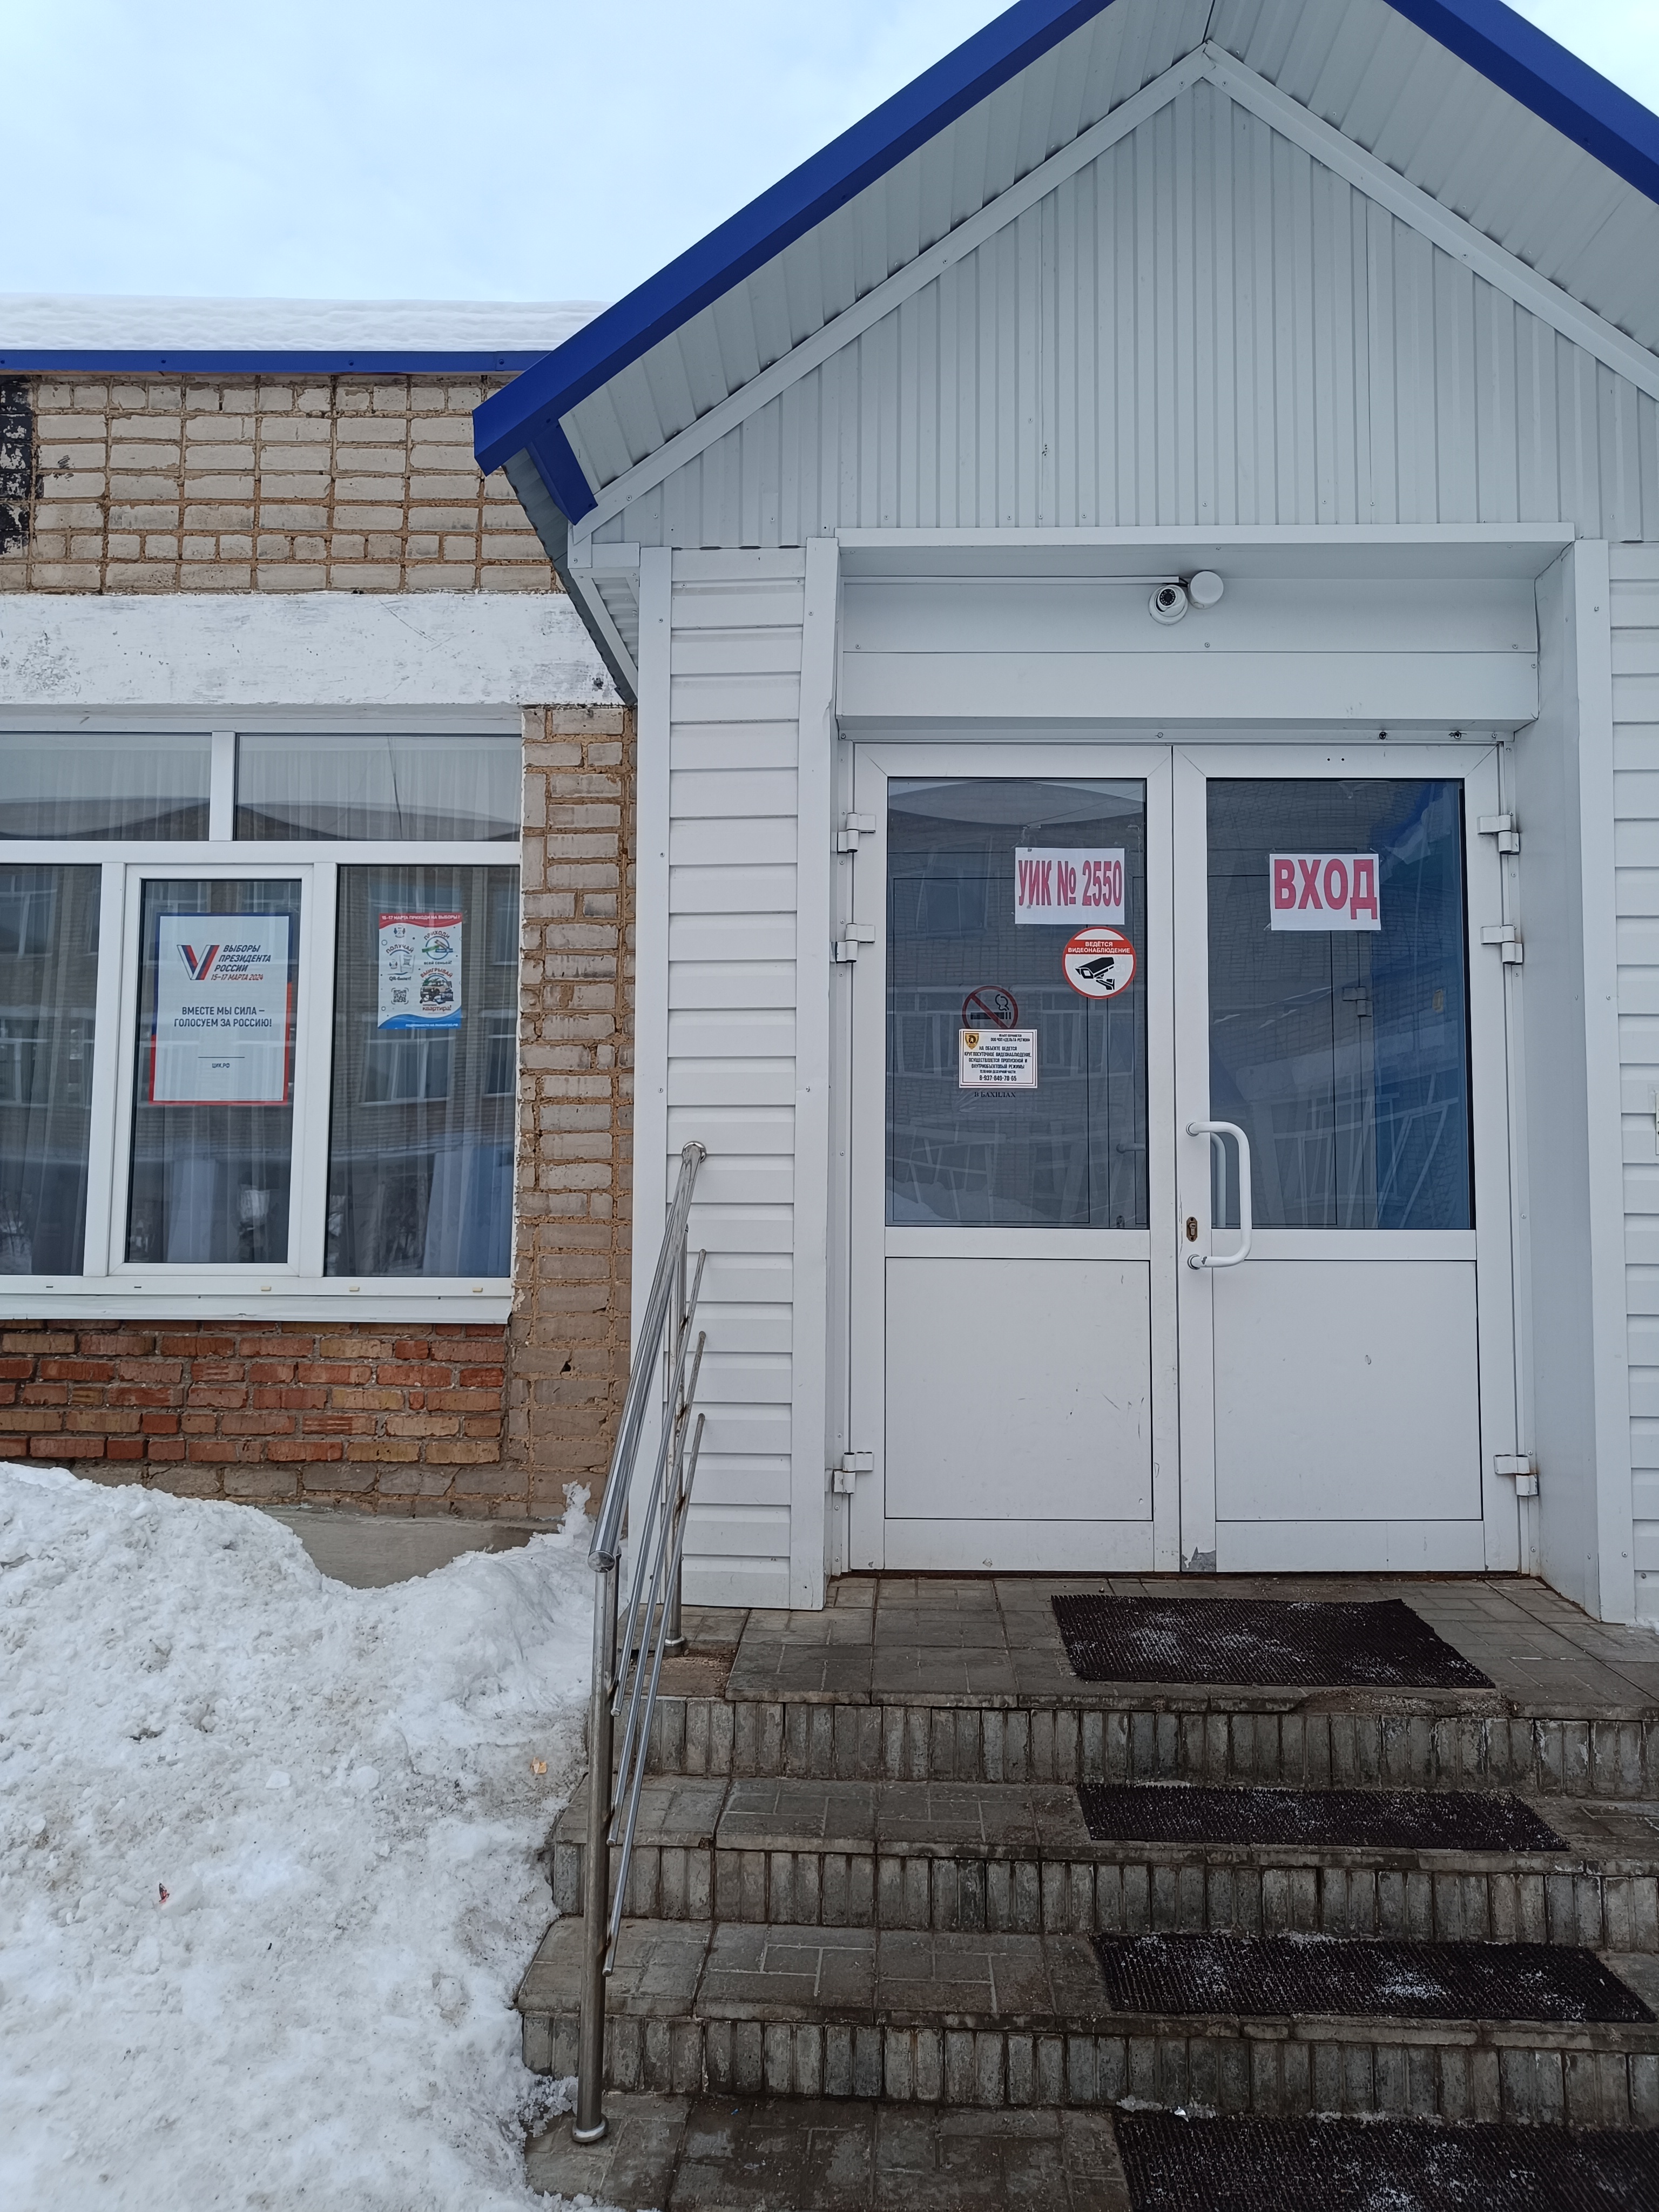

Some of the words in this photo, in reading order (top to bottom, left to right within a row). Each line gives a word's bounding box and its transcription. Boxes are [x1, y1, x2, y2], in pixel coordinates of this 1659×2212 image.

[1019, 860, 1051, 906] УИК
[1057, 860, 1076, 906] №
[1082, 860, 1122, 907] 2550
[1274, 858, 1378, 920] ВХОД
[423, 930, 450, 940] ПРИХОДИ
[386, 944, 414, 954] ПОЛУЧАЙ
[219, 955, 271, 963] ПРЕЗИДЕНТА
[420, 968, 453, 977] ВЫИГРЫВАЙ
[182, 1007, 214, 1015] ВМЕСТЕ
[217, 1007, 232, 1015] МЫ
[234, 1007, 257, 1015] СИЛА
[174, 1019, 218, 1027] ГОЛОСУЕМ
[220, 1019, 231, 1027] ЗА
[233, 1019, 272, 1027] РОССИЮ!
